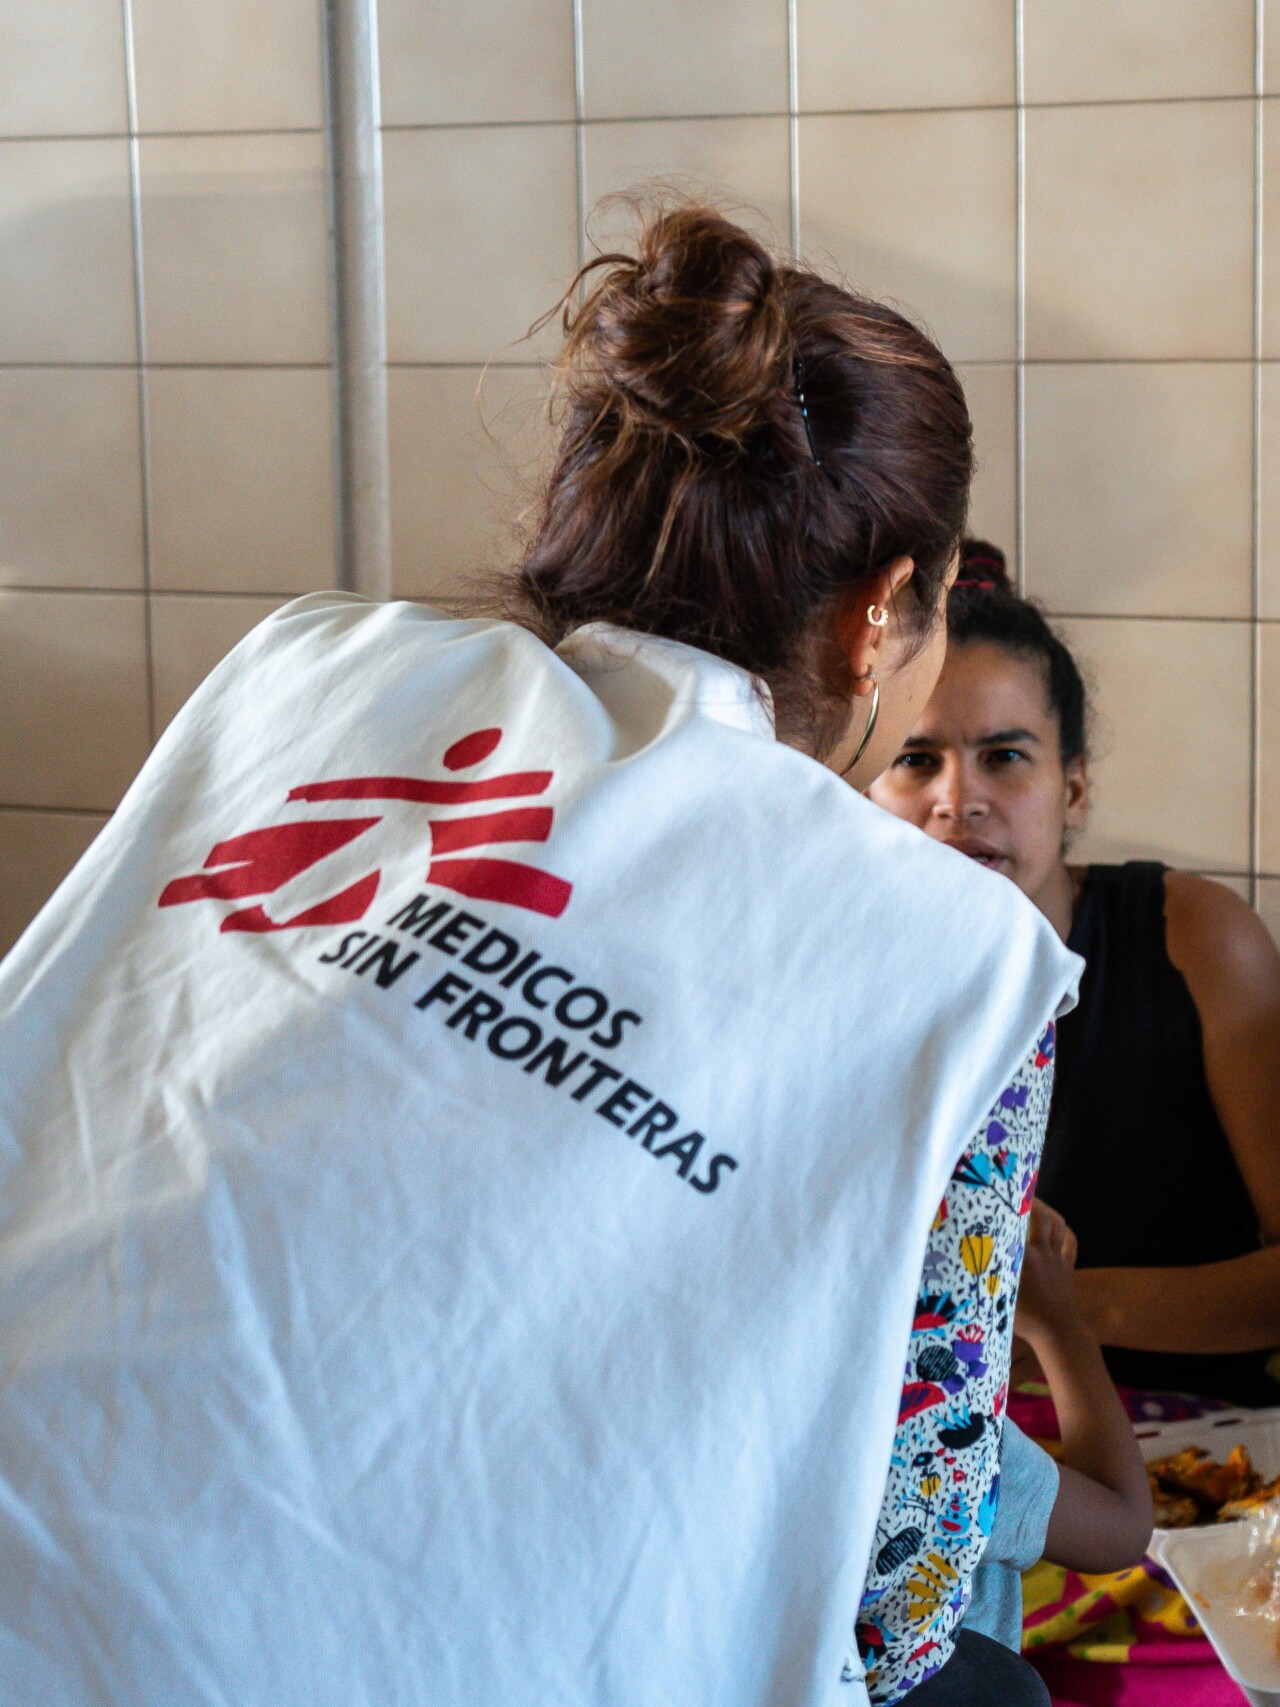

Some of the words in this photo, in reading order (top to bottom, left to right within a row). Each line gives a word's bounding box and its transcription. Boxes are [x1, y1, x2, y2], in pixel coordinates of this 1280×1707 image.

[319, 930, 420, 989] SIN
[414, 971, 737, 1194] FRONTERAS
[386, 893, 642, 1049] MEDICOS
